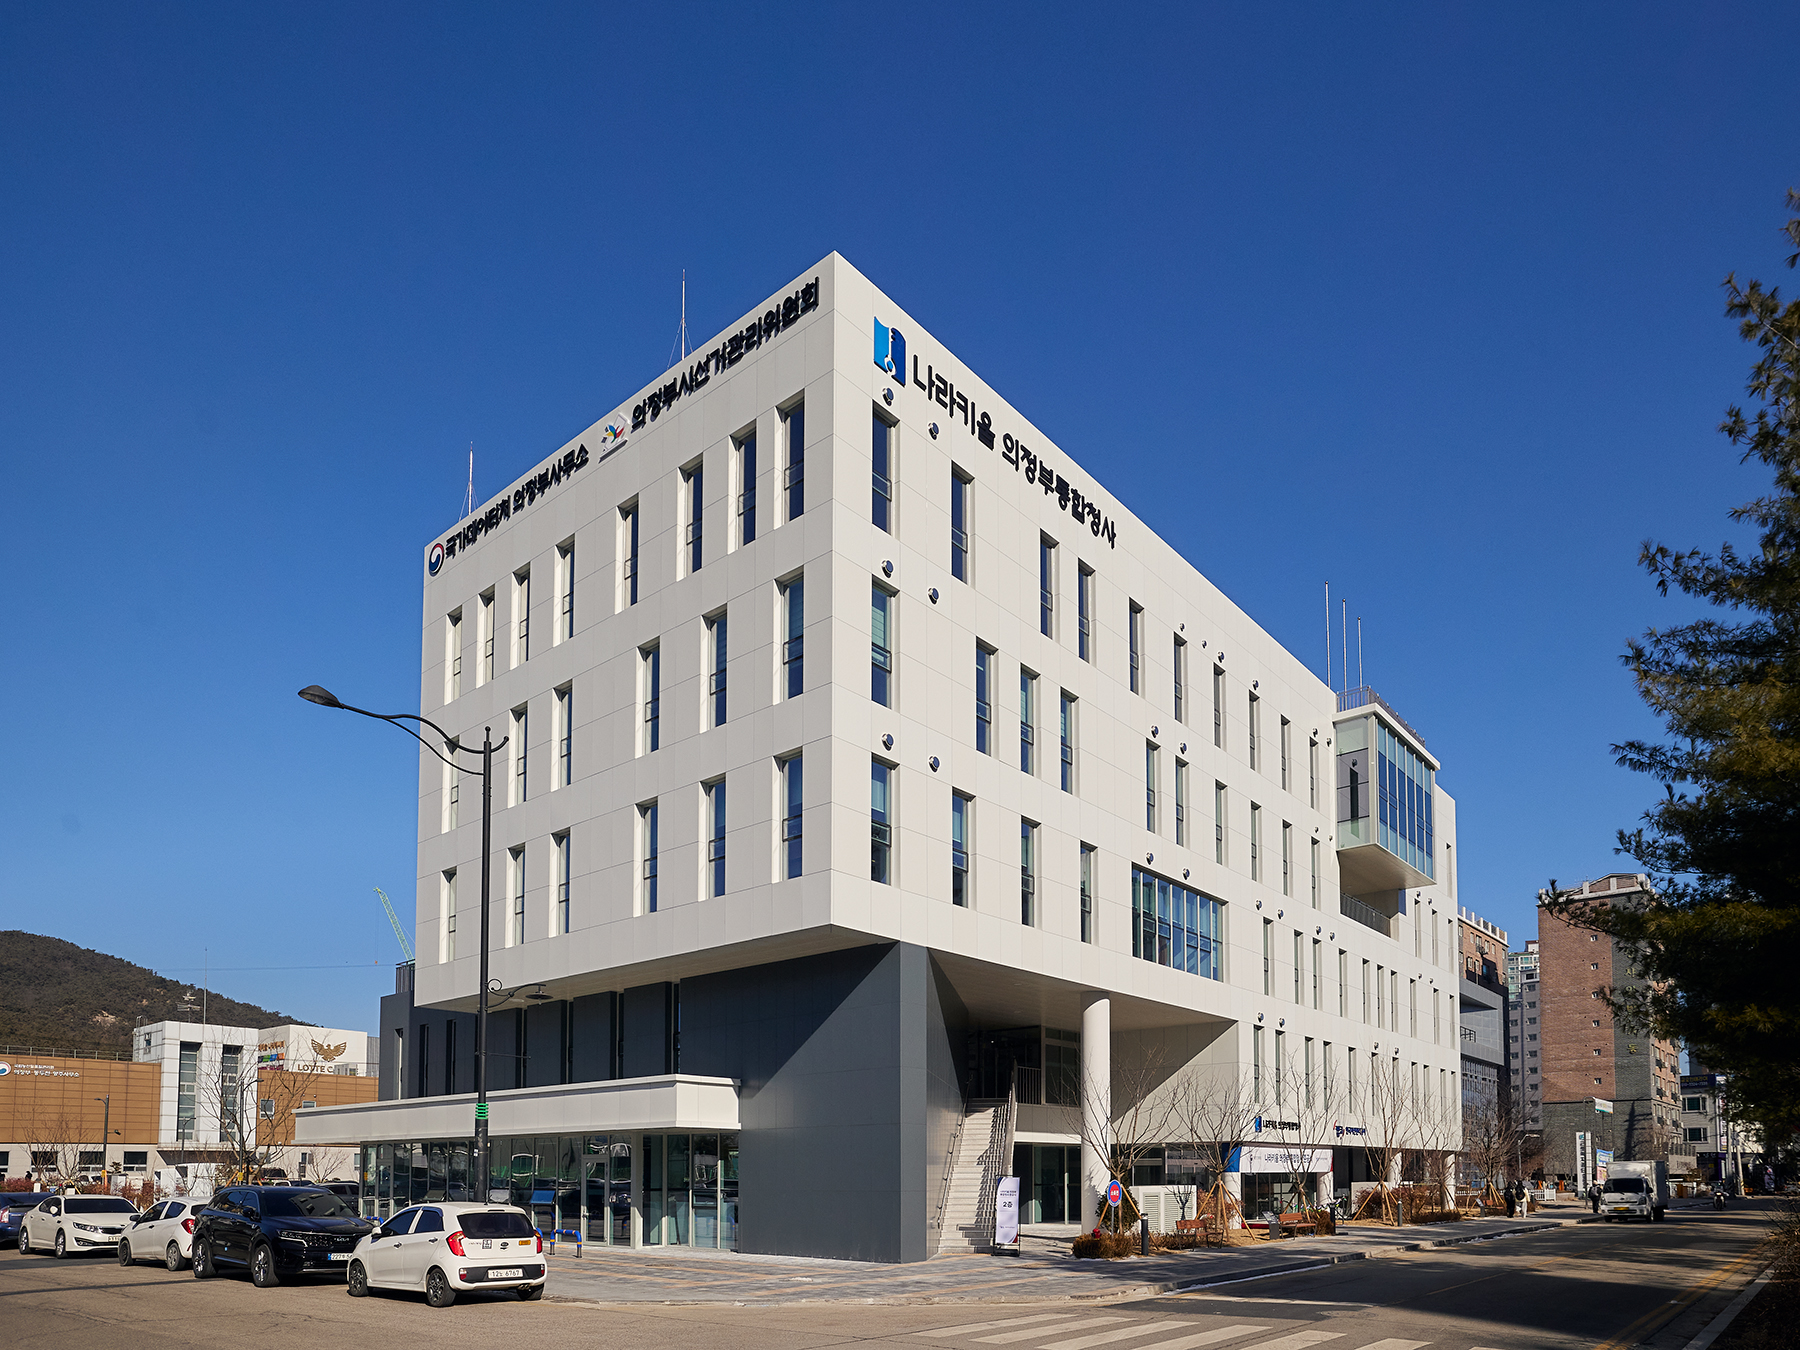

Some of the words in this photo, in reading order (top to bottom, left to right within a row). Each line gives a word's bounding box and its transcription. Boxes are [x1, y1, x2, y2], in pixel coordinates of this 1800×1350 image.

[632, 276, 820, 430] 의정부시선거관리위원회
[512, 444, 589, 514] 의정부사무소
[914, 354, 996, 452] 나라키움
[1002, 433, 1117, 550] 의정부통합청사
[297, 1063, 326, 1073] LOTTE
